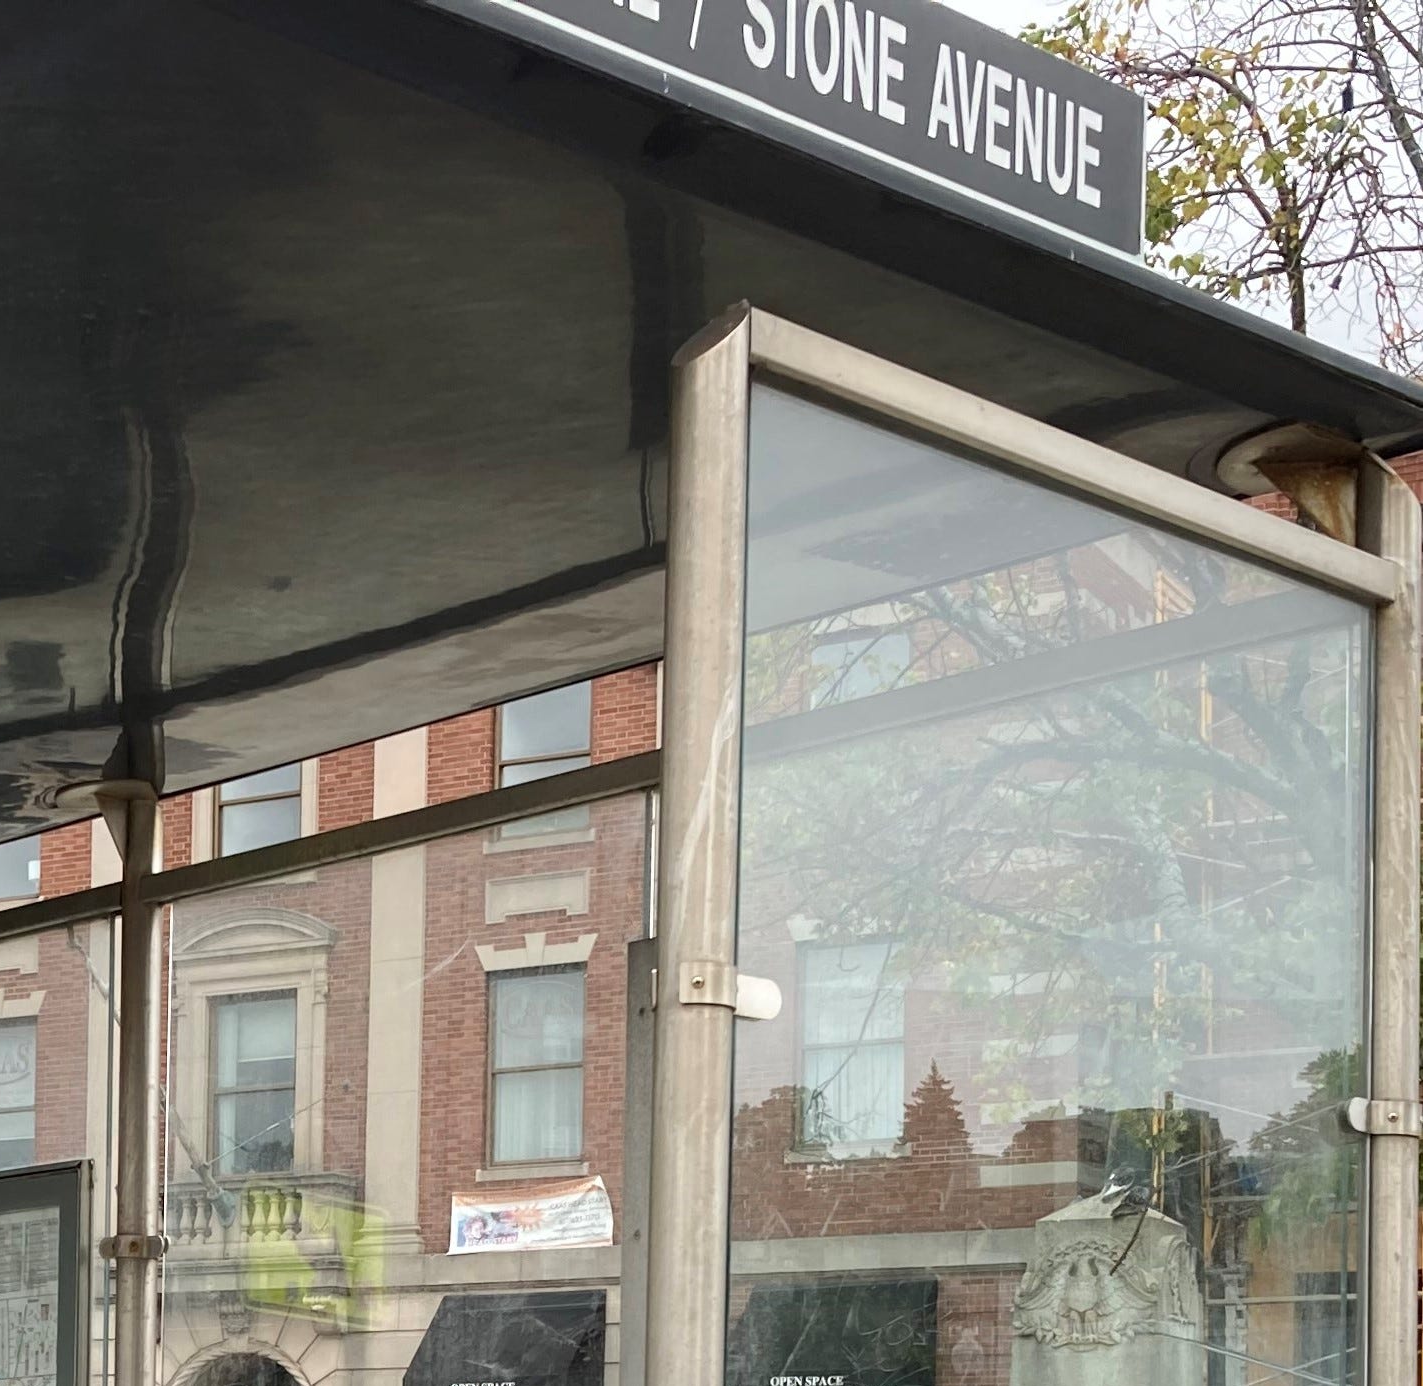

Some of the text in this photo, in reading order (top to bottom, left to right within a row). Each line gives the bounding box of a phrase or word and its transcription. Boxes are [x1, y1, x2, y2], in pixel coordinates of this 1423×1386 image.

[742, 0, 907, 125] STONE
[928, 43, 1103, 208] AVENUE
[770, 1375, 844, 1386] OPEN SPACE
